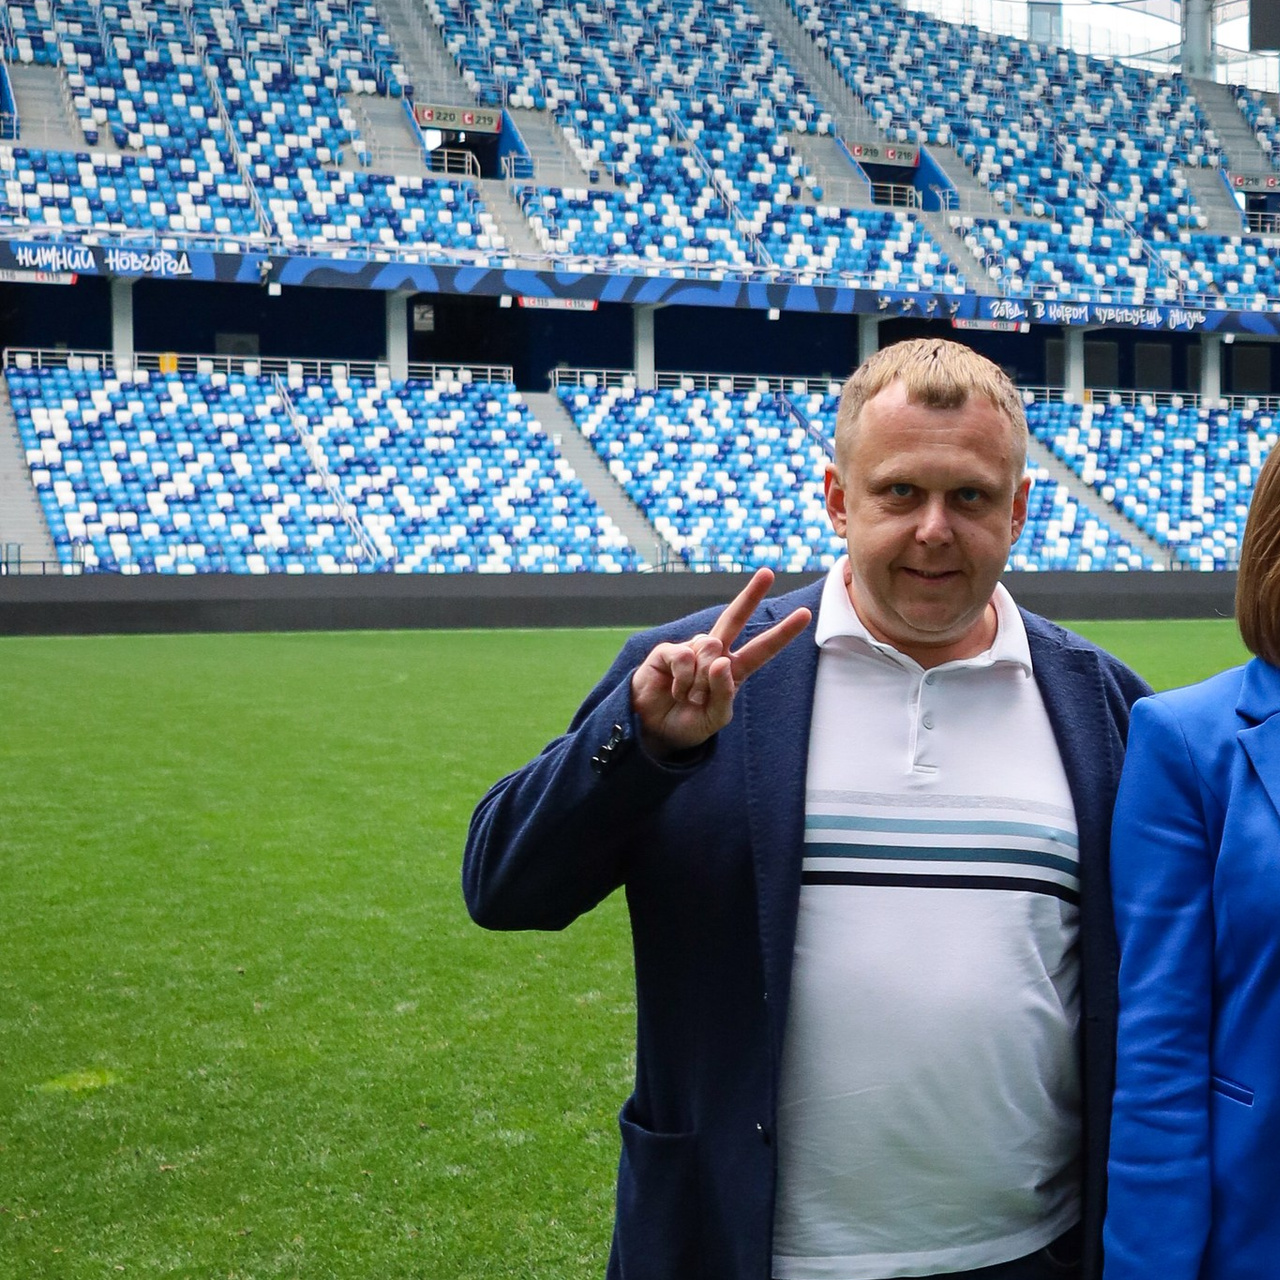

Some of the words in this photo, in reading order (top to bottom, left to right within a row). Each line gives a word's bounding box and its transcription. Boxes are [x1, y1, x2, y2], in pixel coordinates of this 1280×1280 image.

[436, 111, 456, 121] 220
[475, 115, 494, 126] 219
[863, 147, 879, 158] 219
[16, 246, 96, 272] НИЖНИЙ
[104, 247, 192, 276] НОВГОРОД
